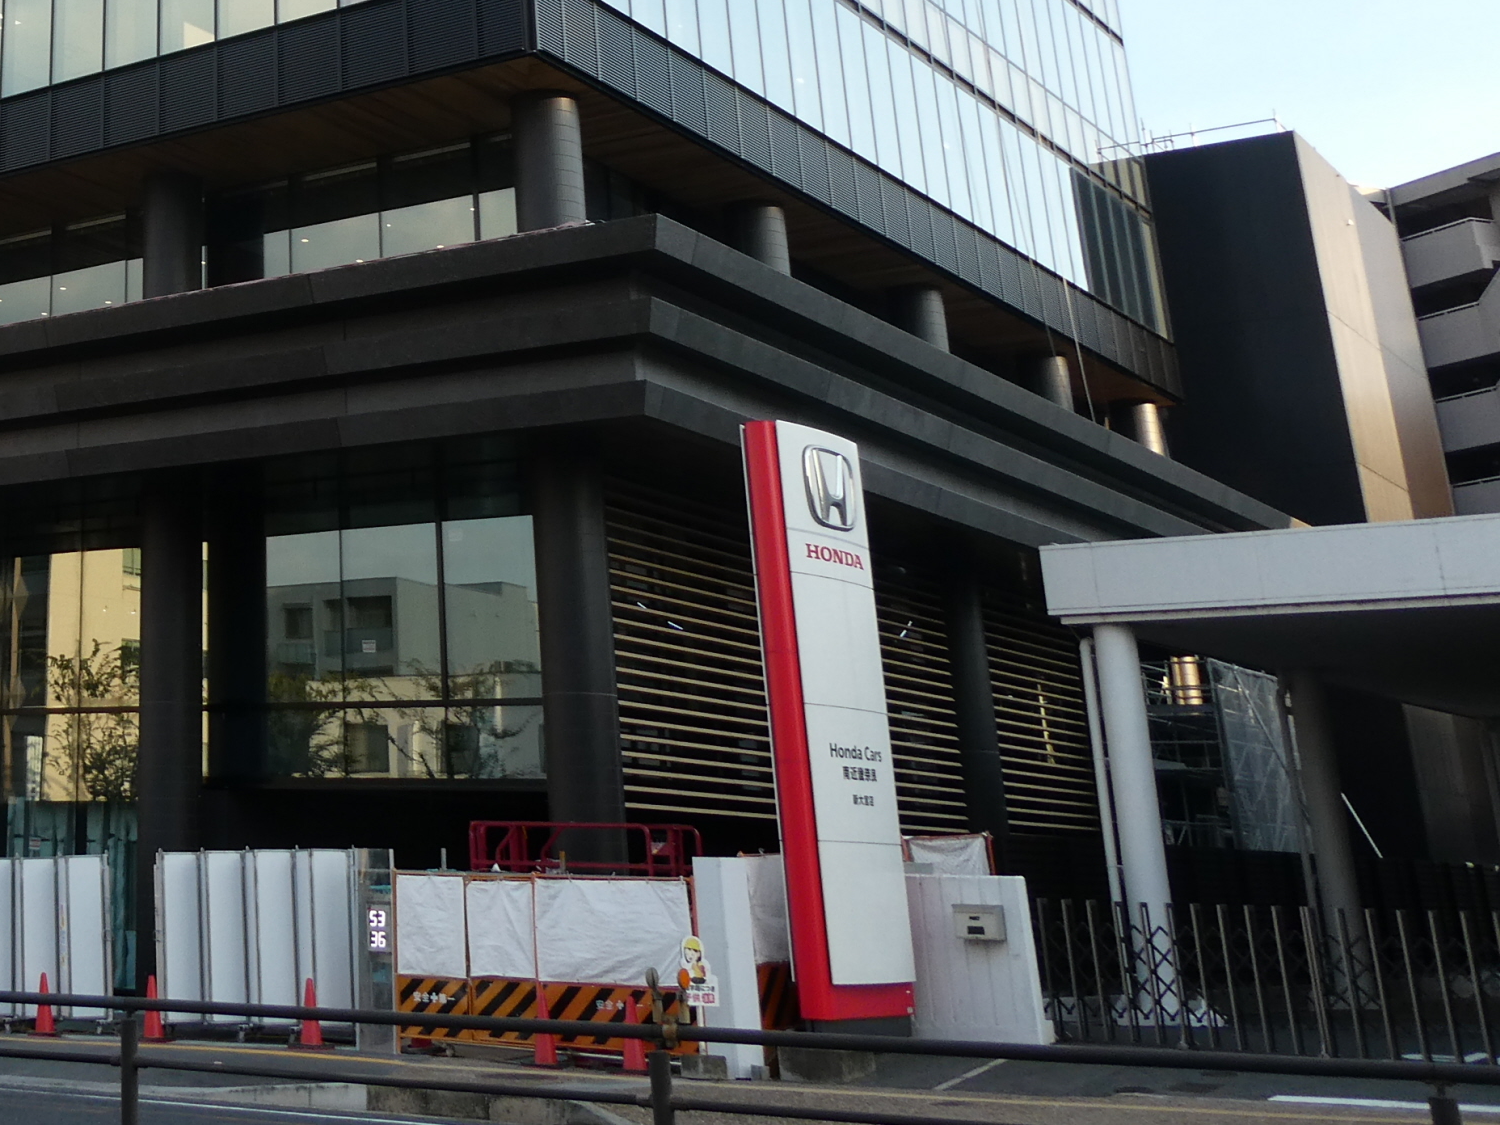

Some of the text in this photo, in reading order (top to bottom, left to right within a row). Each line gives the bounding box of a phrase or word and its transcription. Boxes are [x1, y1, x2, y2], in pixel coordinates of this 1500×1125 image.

[805, 543, 864, 570] HONDA
[829, 743, 882, 762] Honda Cars
[369, 910, 386, 927] 53
[370, 931, 387, 947] 36
